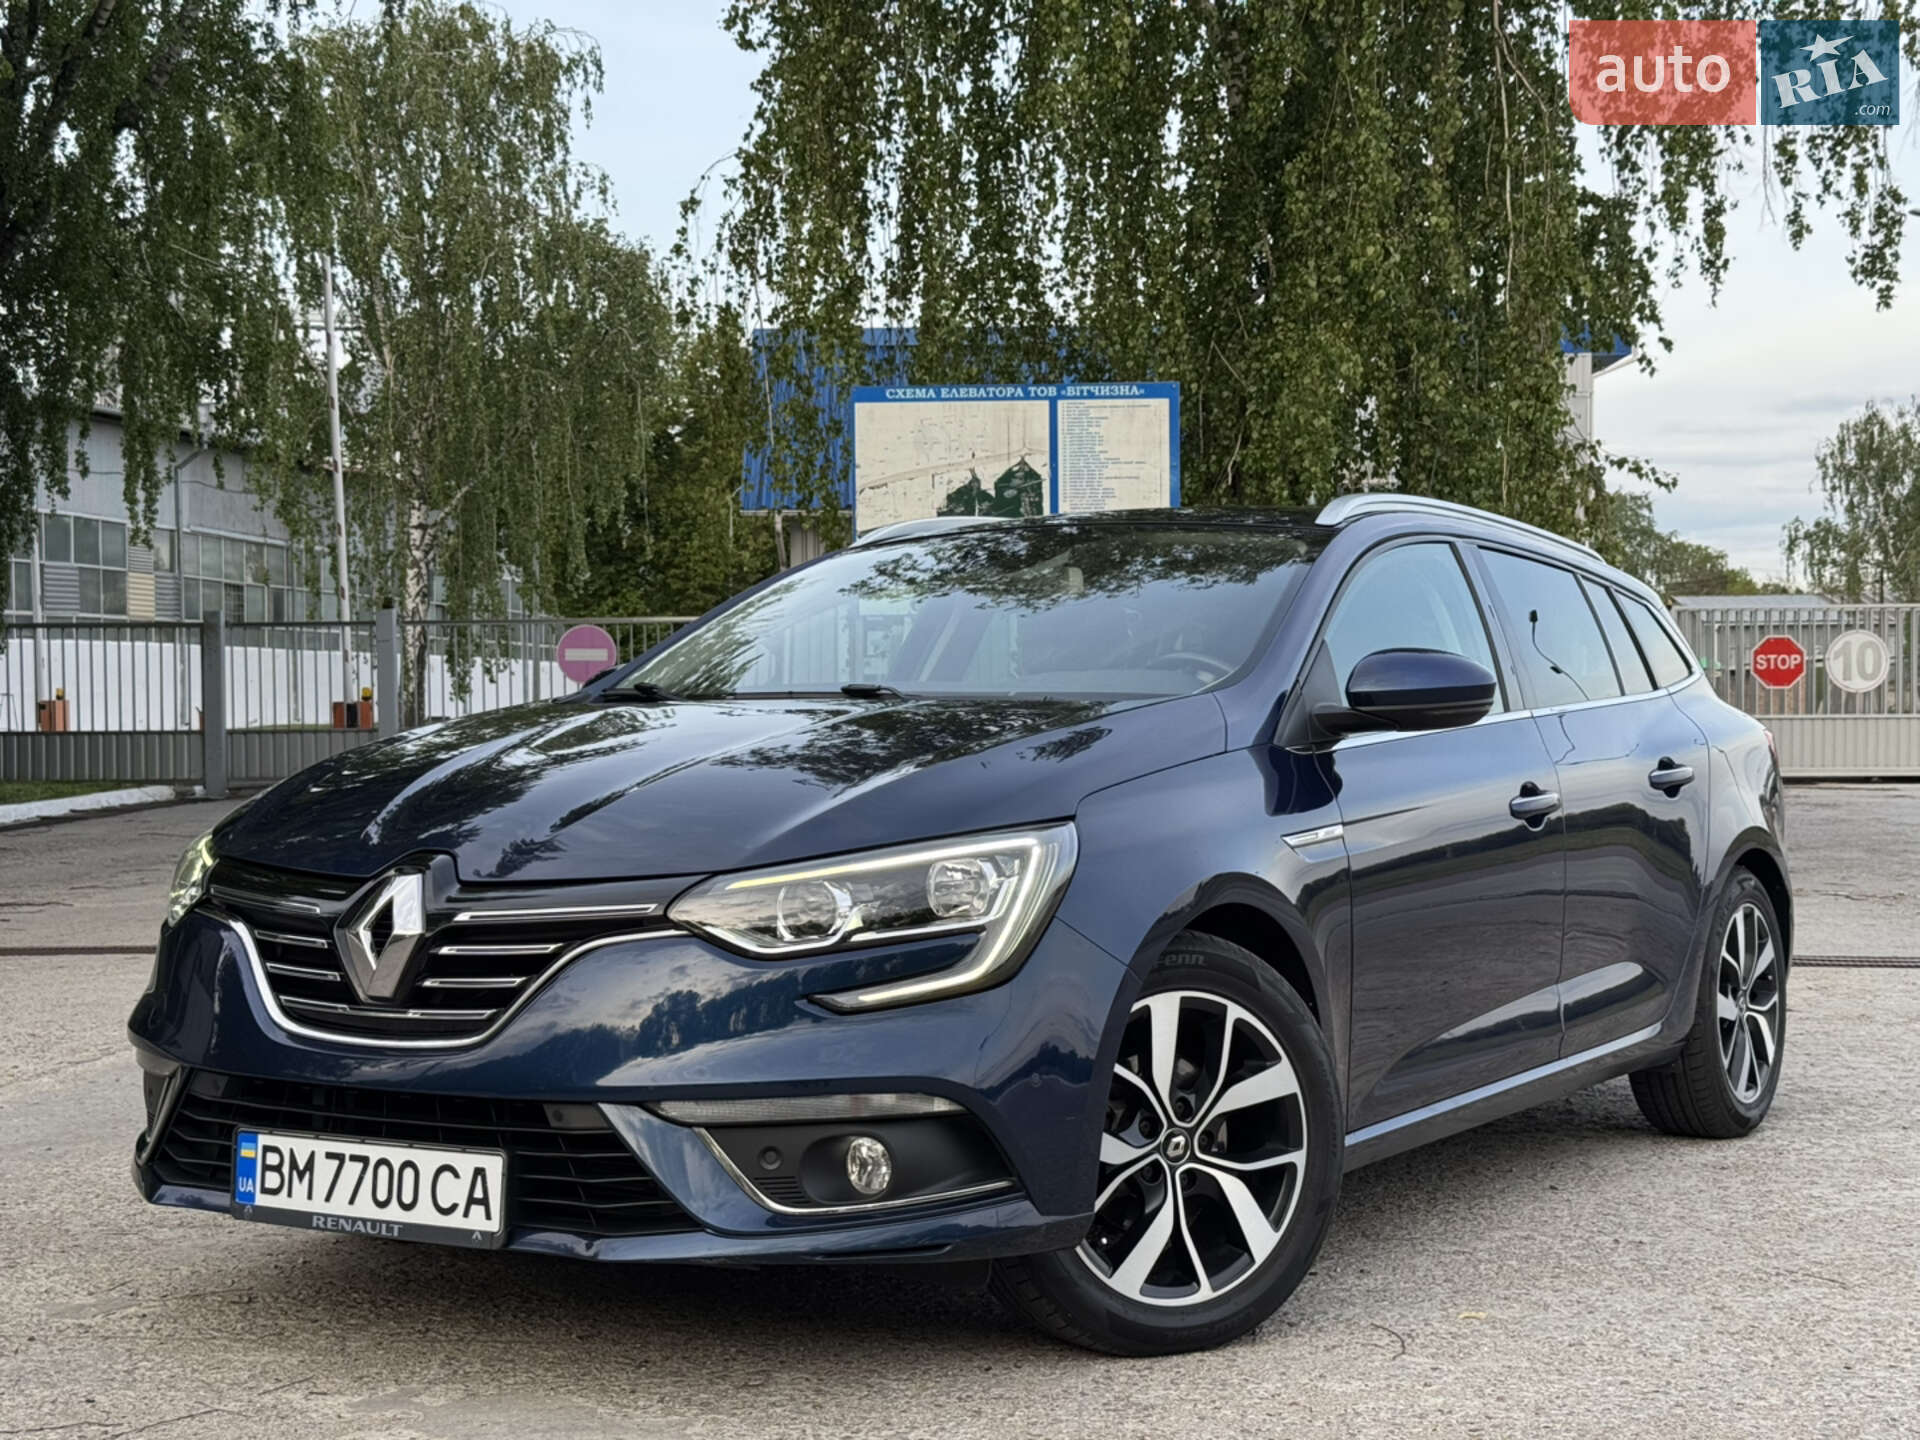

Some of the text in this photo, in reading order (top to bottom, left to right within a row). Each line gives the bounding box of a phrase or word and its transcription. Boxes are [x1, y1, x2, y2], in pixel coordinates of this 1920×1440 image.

[886, 388, 936, 399] СХЕМА
[941, 387, 1024, 399] ЕЛЕВАТОРА
[1028, 386, 1057, 397] ТОВ
[1756, 654, 1801, 670] STOP
[1833, 640, 1882, 682] 10
[238, 1176, 255, 1193] UA
[260, 1144, 492, 1220] BM 7700 CA
[312, 1214, 403, 1237] RENAULT
